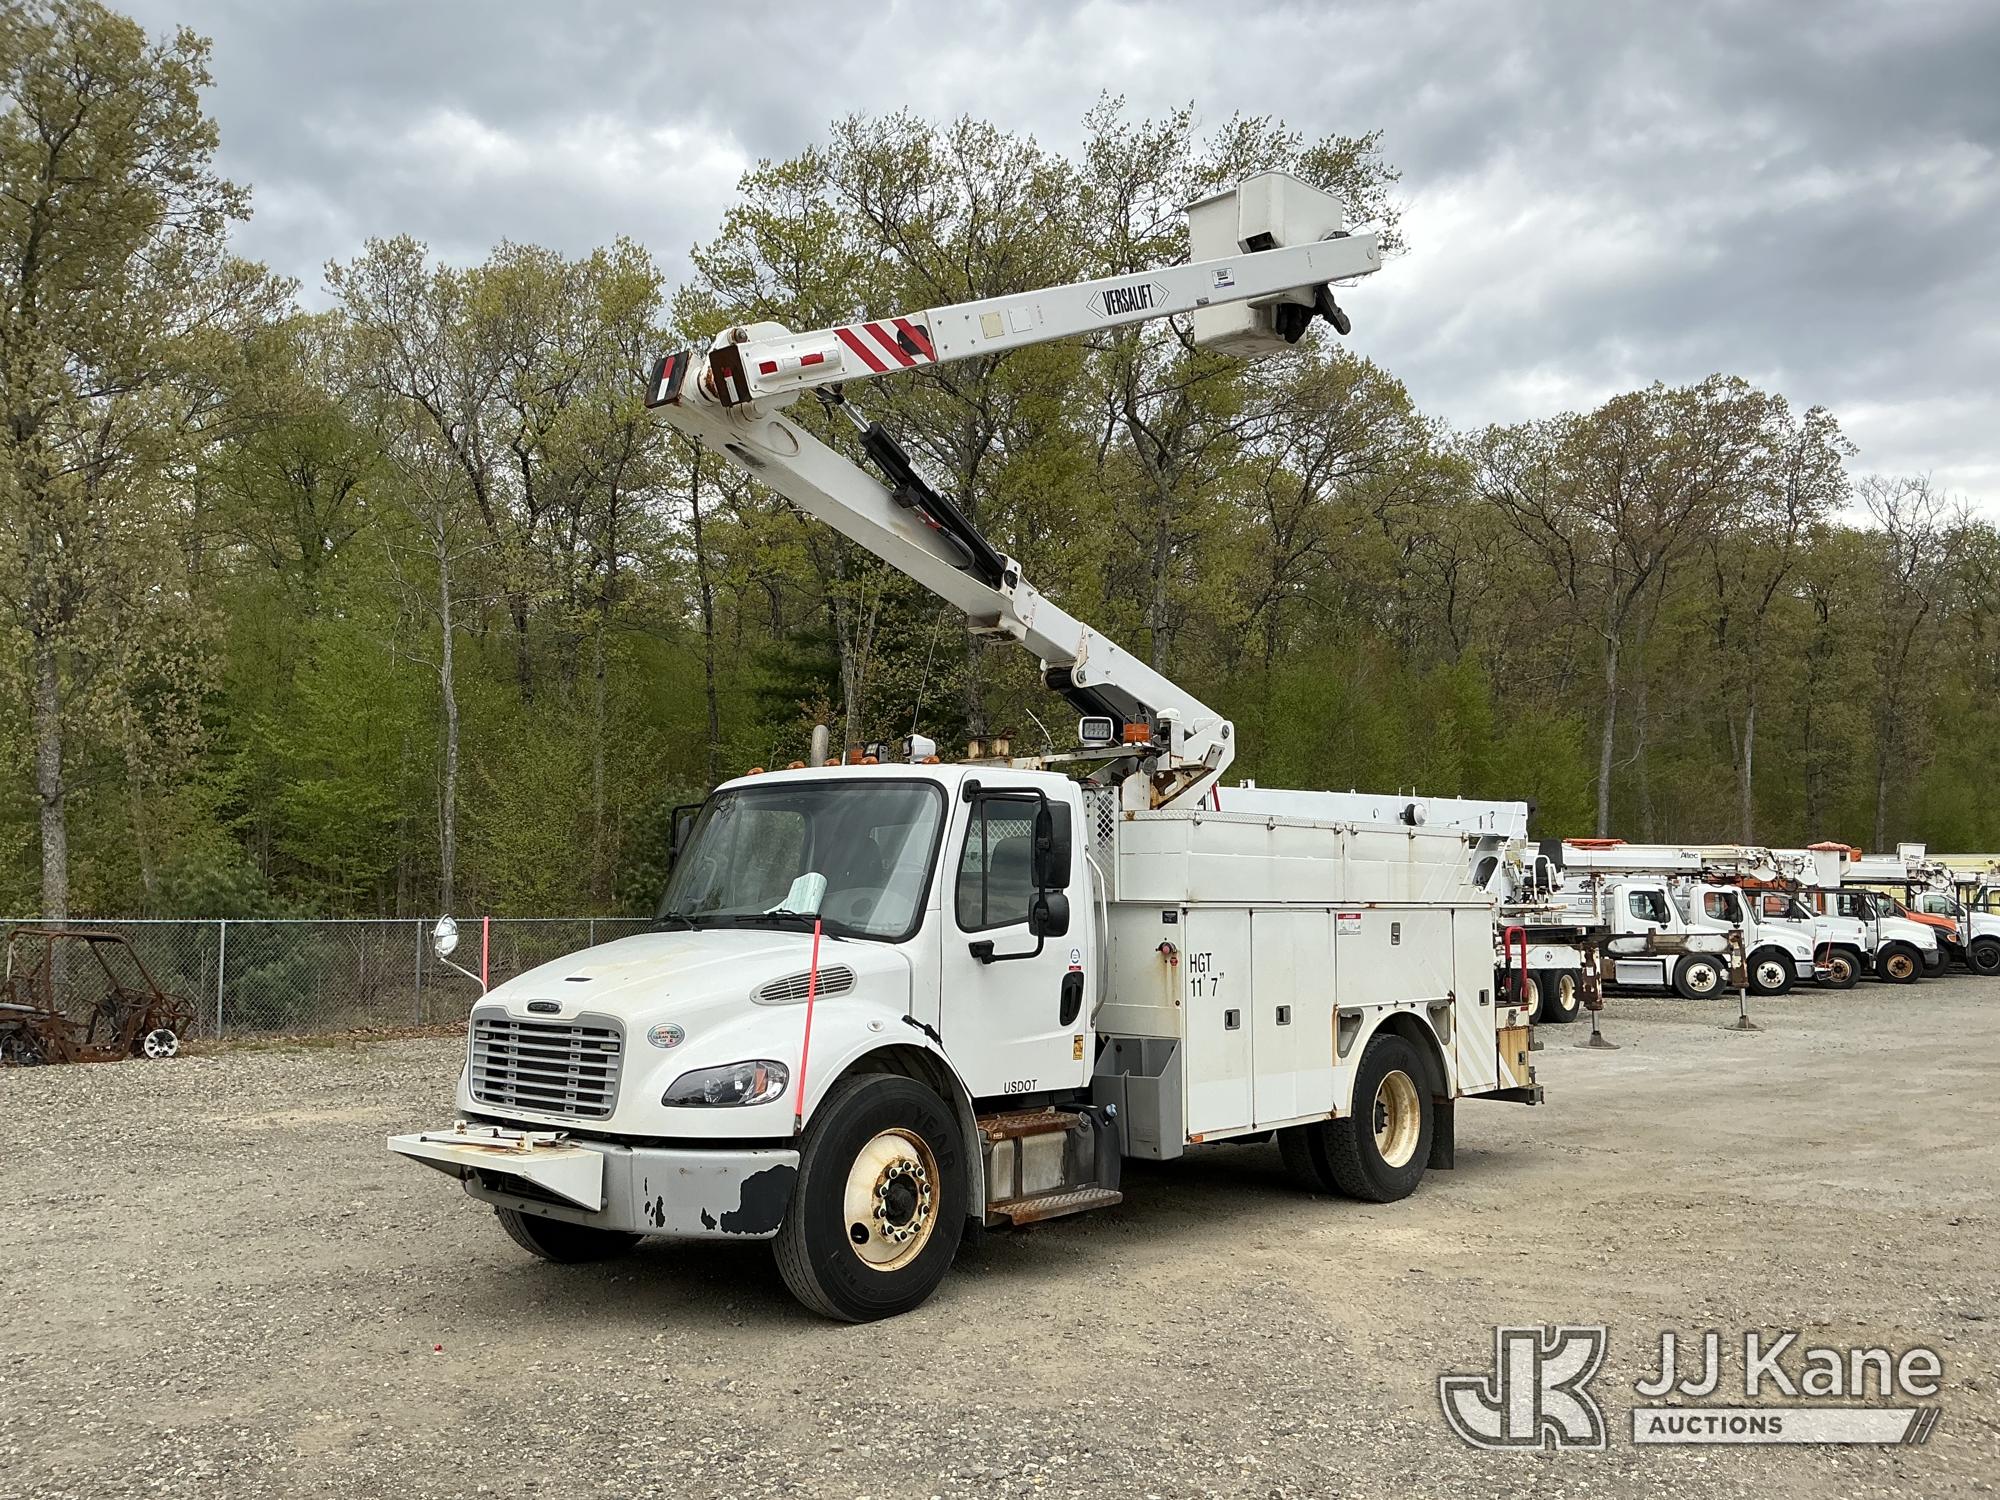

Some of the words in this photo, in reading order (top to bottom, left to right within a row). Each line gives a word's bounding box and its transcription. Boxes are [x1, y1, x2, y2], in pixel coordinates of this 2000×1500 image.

[1102, 284, 1154, 316] VERSALIFT
[1680, 851, 1699, 859] Altec
[1189, 952, 1212, 973] HGT
[1004, 1080, 1037, 1094] USDOT
